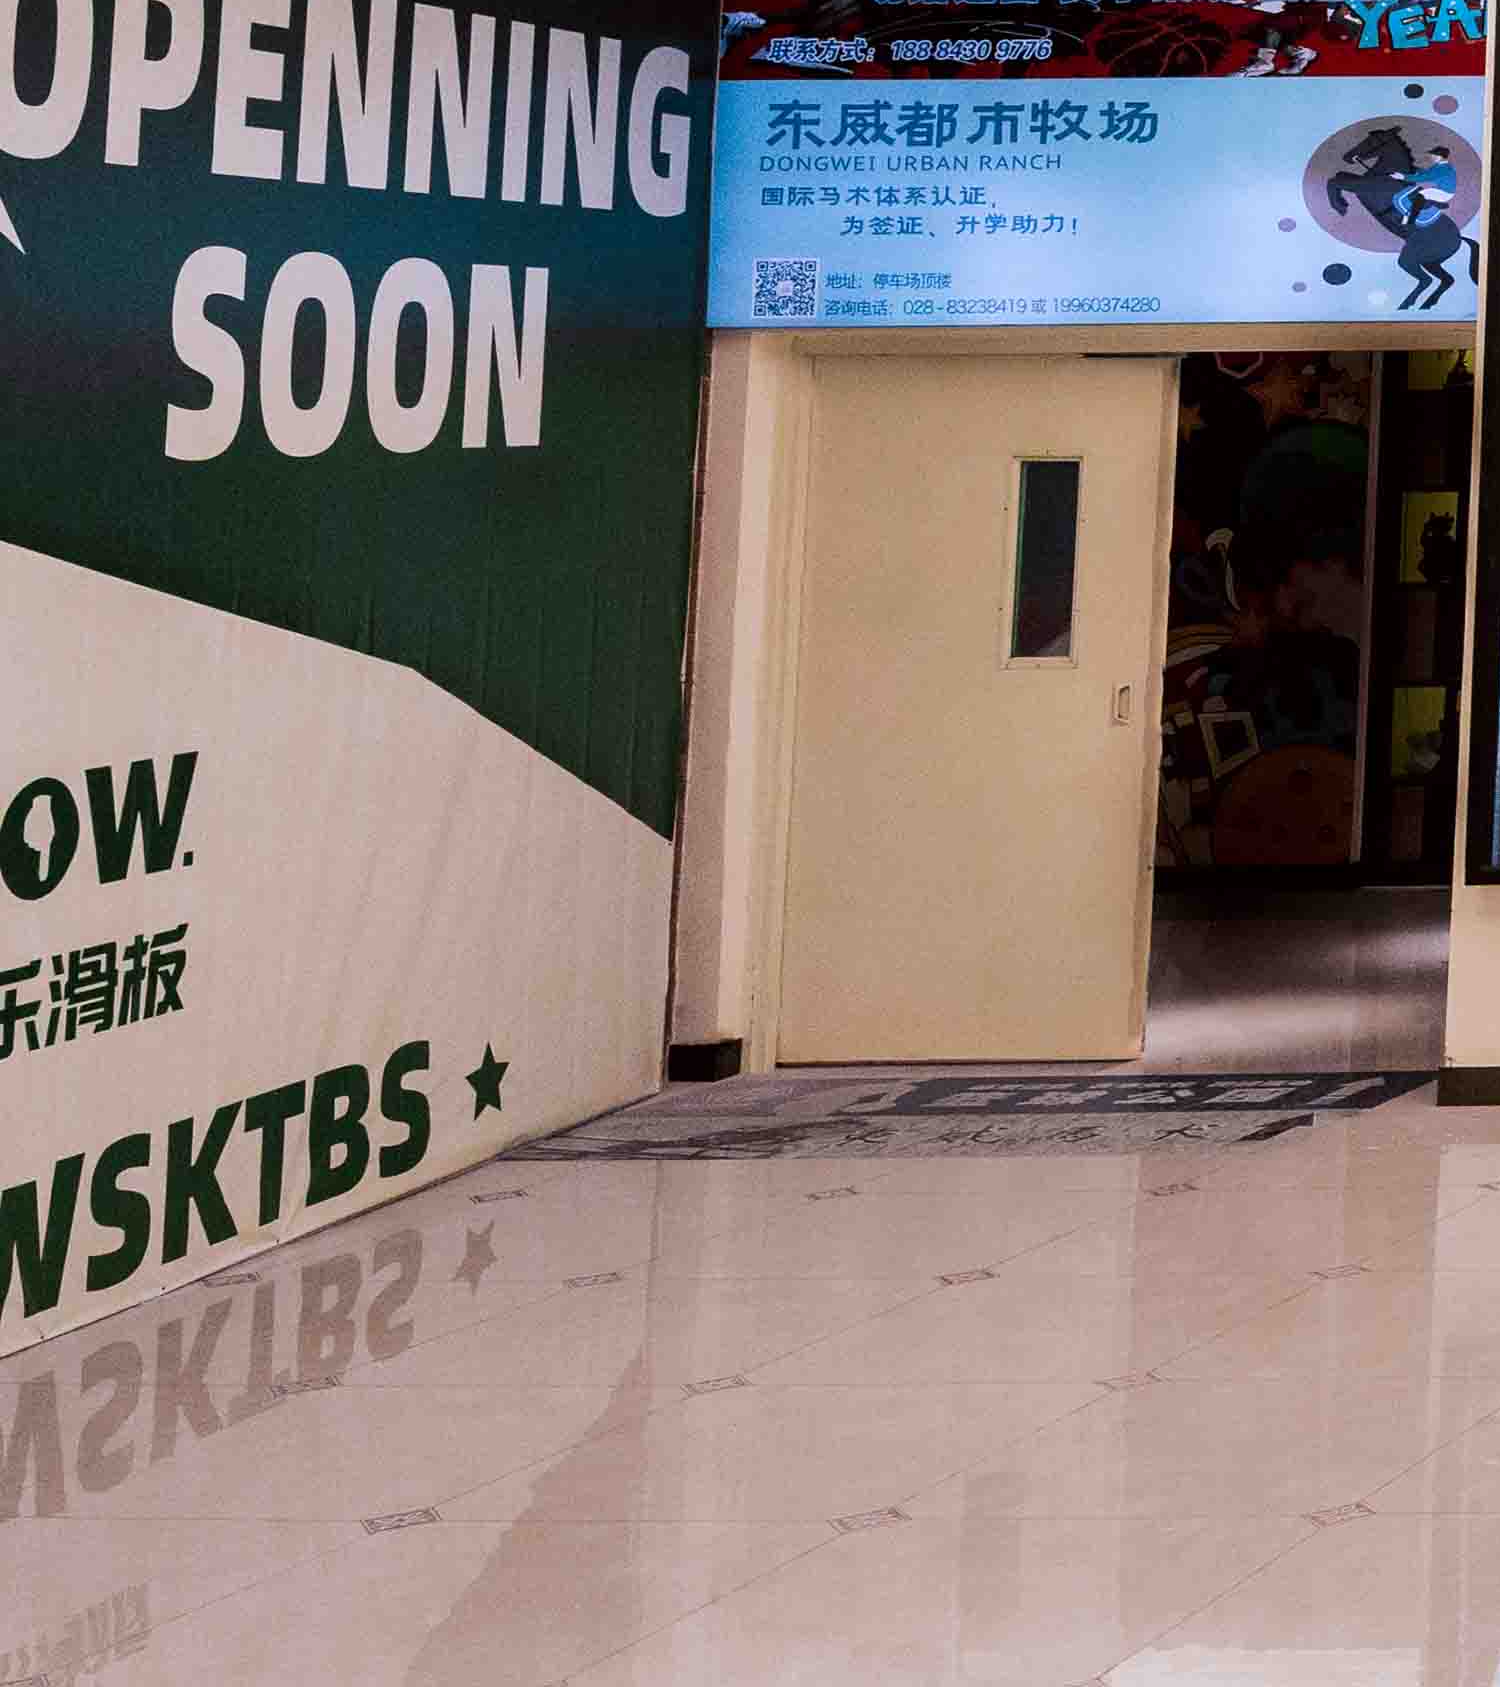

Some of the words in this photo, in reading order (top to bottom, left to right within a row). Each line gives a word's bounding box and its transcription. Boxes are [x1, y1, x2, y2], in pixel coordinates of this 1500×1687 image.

[891, 39, 931, 61] 188
[935, 39, 993, 61] 8430
[994, 38, 1054, 61] 9776
[765, 99, 1159, 150] 东威都市牧场
[759, 155, 876, 172] DONGWEI
[887, 154, 970, 172] URBAN
[979, 153, 1063, 170] RANCH
[164, 245, 550, 462] SOON
